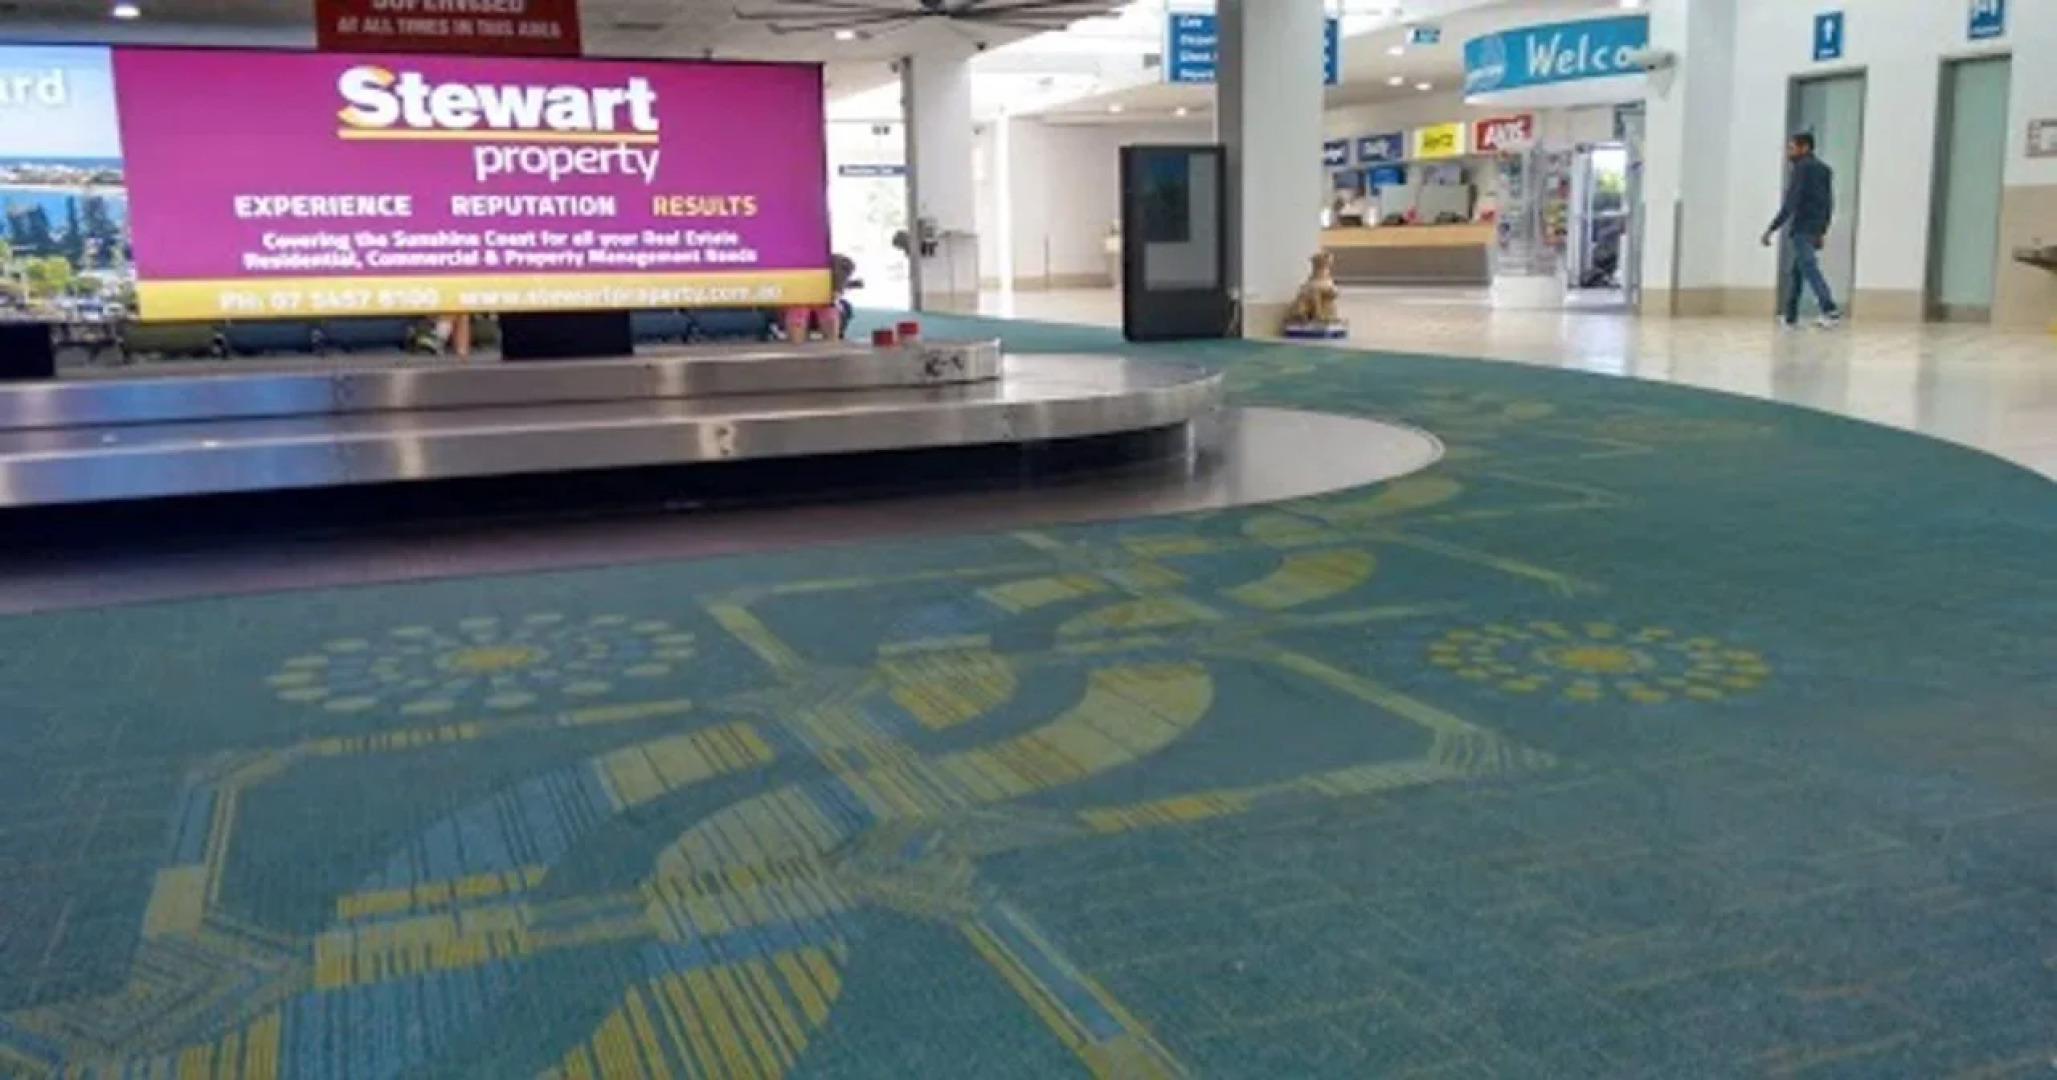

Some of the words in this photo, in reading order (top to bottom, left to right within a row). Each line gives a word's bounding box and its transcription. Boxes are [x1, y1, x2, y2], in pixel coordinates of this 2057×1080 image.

[361, 16, 395, 34] ALL
[397, 18, 449, 35] TIMES
[477, 19, 514, 36] THIS
[518, 20, 561, 38] AREA
[337, 65, 658, 131] Stewart
[474, 142, 660, 184] property
[234, 195, 412, 218] EXPERIENCE
[451, 195, 616, 217] REPUTATION
[653, 195, 758, 217] RESULTS
[262, 230, 351, 251] Covering
[354, 231, 388, 247] the
[391, 230, 479, 247] Sunshine
[484, 229, 535, 247] Coast
[540, 230, 568, 247] for
[571, 229, 594, 246] all
[598, 232, 638, 249] your
[641, 229, 680, 246] Real
[685, 229, 738, 246] Estate
[243, 251, 363, 270] Residential,
[366, 250, 479, 267] Commercial
[484, 249, 498, 266] &
[503, 249, 585, 268] Property
[588, 248, 701, 267] Management
[704, 248, 758, 263] Needs
